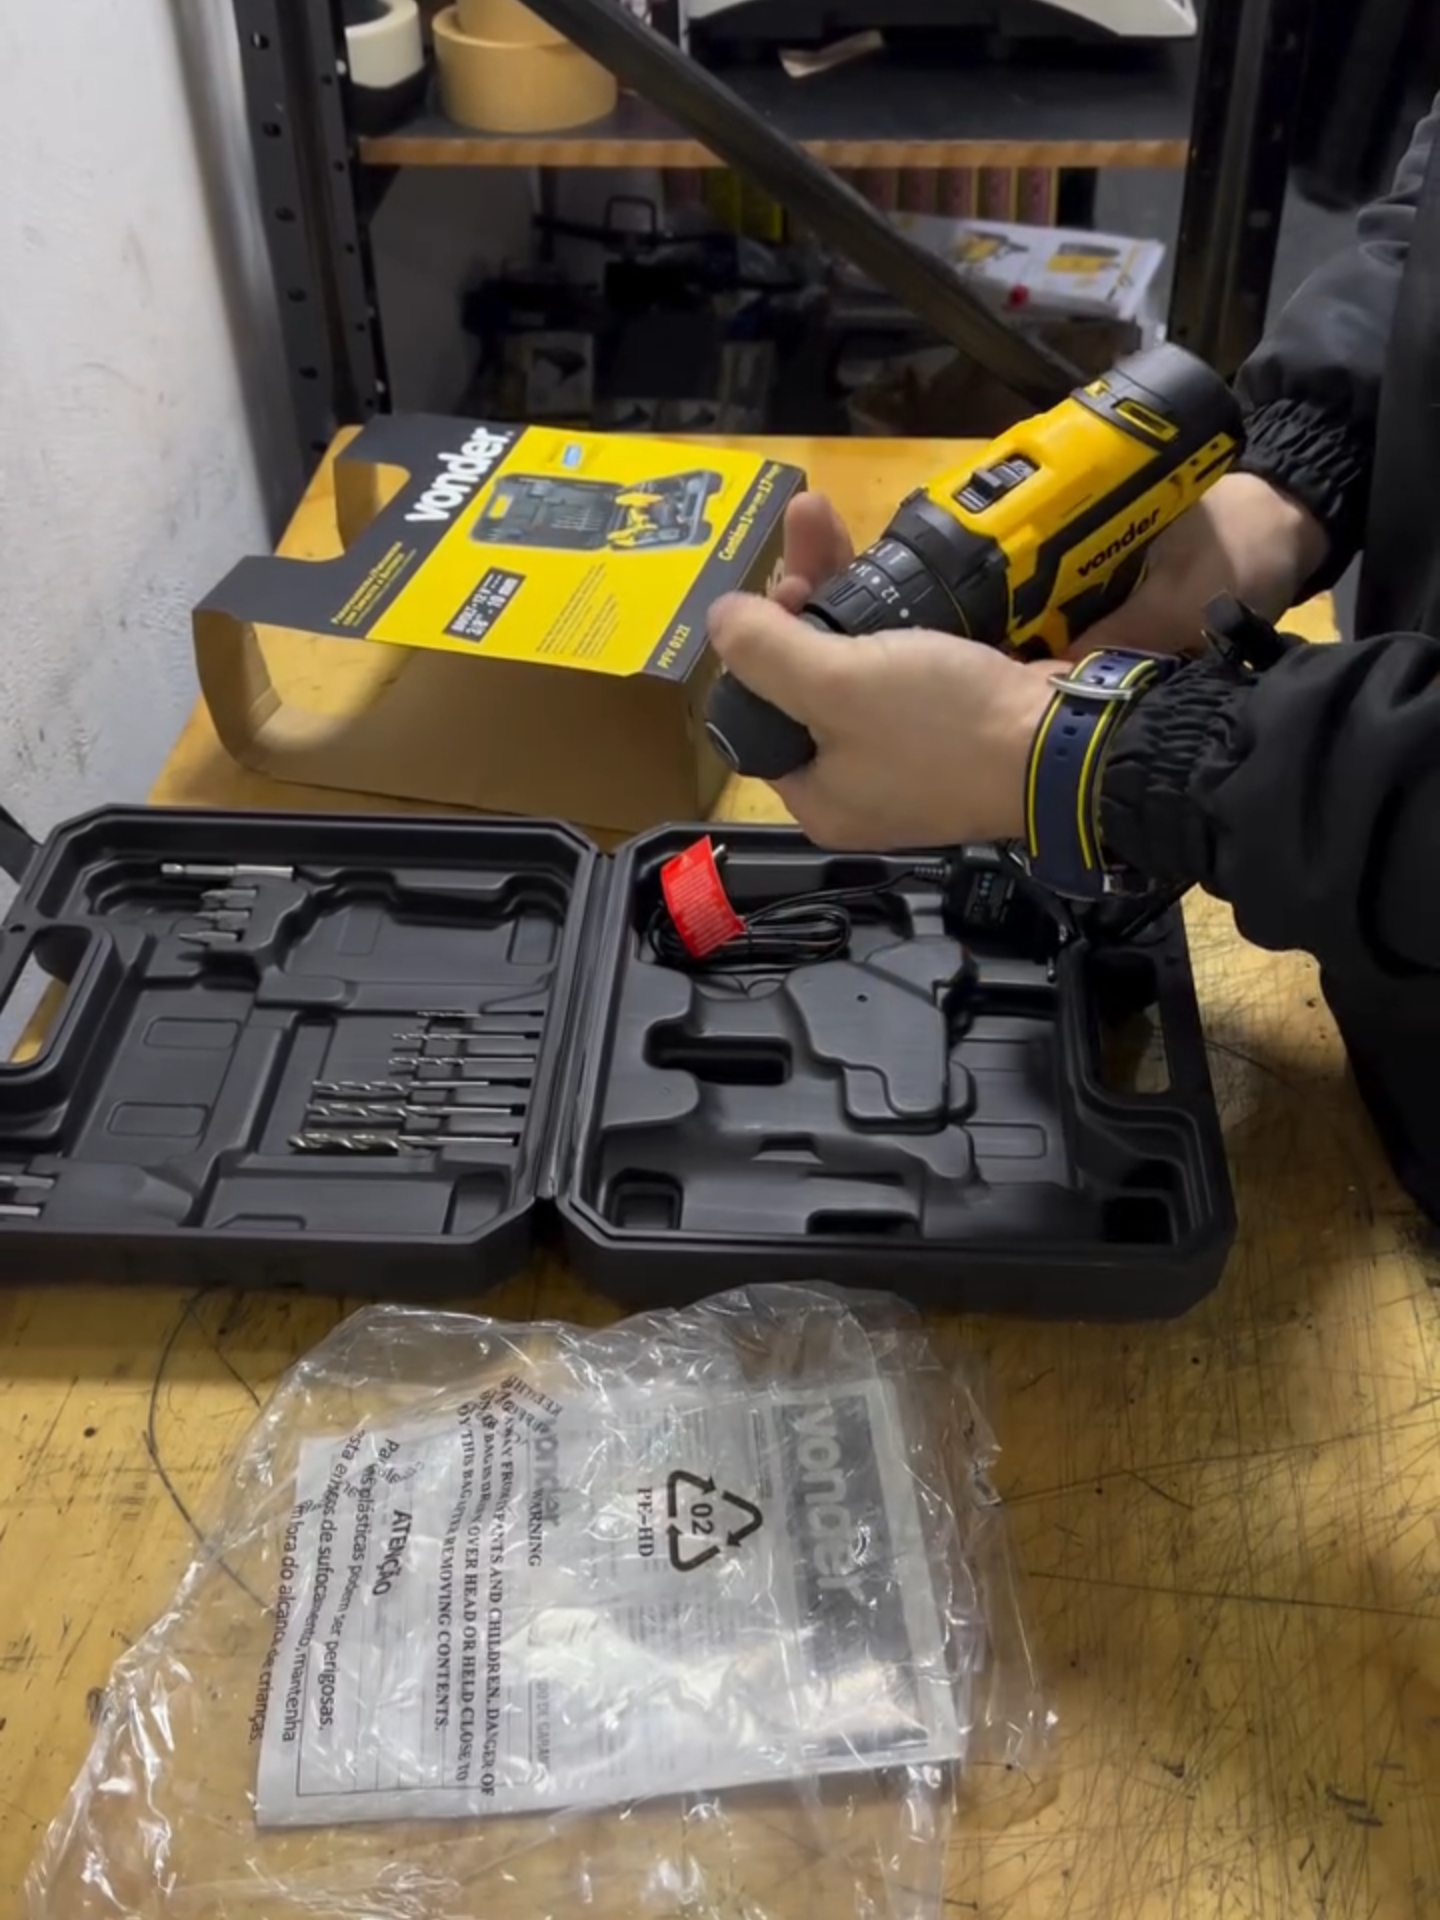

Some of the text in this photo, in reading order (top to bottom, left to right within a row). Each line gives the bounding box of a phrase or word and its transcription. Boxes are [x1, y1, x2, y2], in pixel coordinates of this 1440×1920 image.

[404, 426, 510, 522] vonder
[1077, 507, 1161, 577] vonder
[881, 585, 900, 605] 12
[657, 647, 677, 670] PFV
[461, 1429, 476, 1467] THIS
[459, 1468, 474, 1500] BAG
[795, 1407, 865, 1602] vonder
[319, 1519, 337, 1543] de
[352, 1487, 375, 1561] plásticas
[528, 1488, 544, 1567] WARNING
[690, 1502, 714, 1535] 02
[281, 1555, 299, 1581] do
[371, 1509, 413, 1596] ATENÇÃO
[465, 1523, 484, 1571] OVER
[437, 1535, 457, 1626] REMOVING
[464, 1573, 479, 1622] HEAD
[488, 1568, 503, 1604] AND
[463, 1625, 477, 1651] OR
[485, 1608, 502, 1704] CHILDREN.
[281, 1653, 307, 1743] mantenha
[317, 1640, 340, 1731] perigosas.
[434, 1630, 452, 1731] CONTENTS.
[461, 1655, 476, 1703] HELD
[247, 1671, 272, 1746] crianças.
[459, 1707, 475, 1761] CLOSE
[457, 1763, 472, 1781] TO
[481, 1773, 496, 1797] OF
